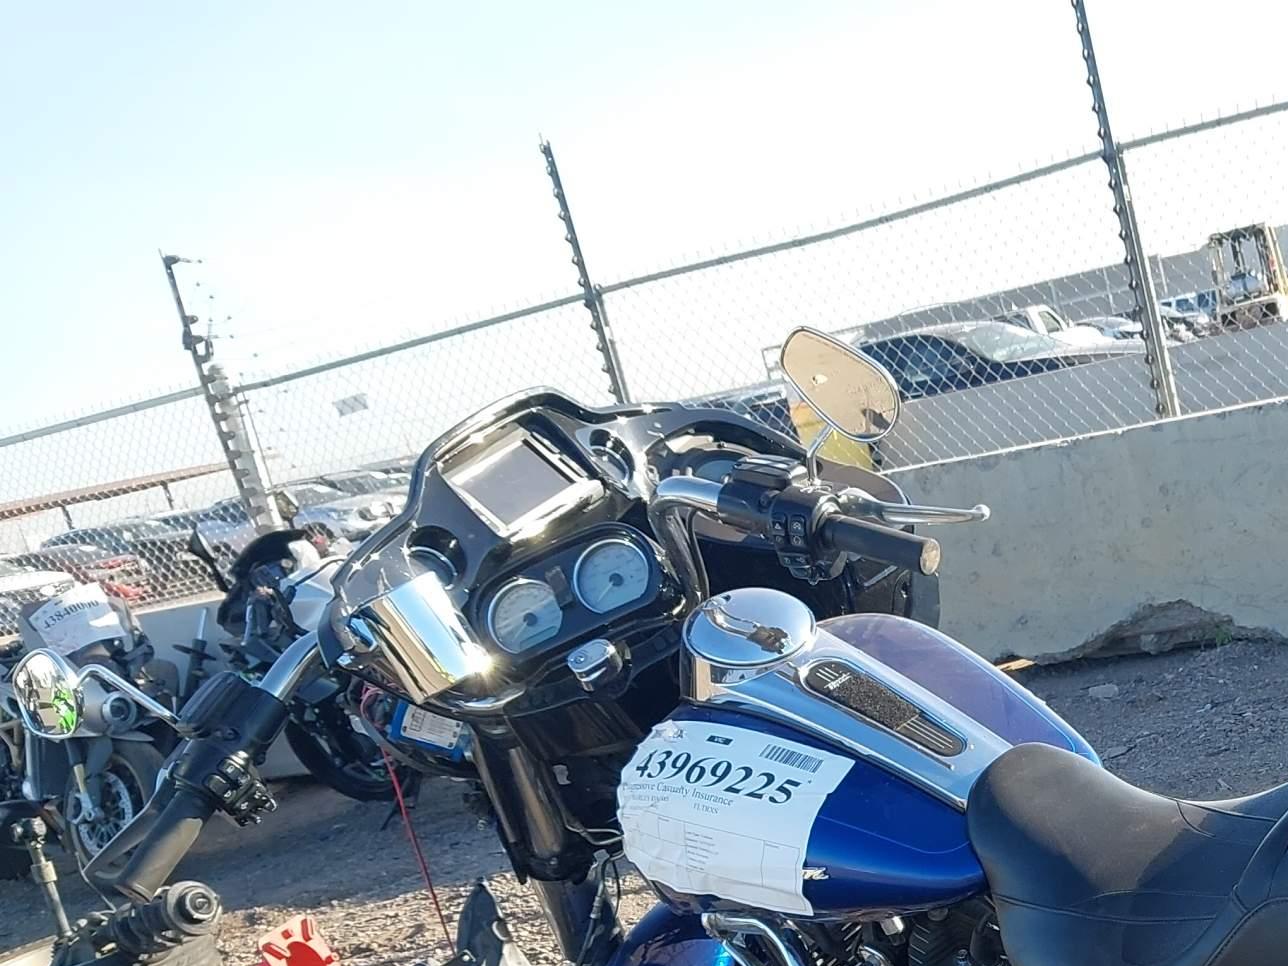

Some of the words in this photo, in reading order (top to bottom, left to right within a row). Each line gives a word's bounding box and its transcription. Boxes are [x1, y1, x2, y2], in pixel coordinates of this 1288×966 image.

[635, 749, 803, 804] 43969225
[656, 783, 690, 798] Casualty
[691, 787, 734, 806] Insurance
